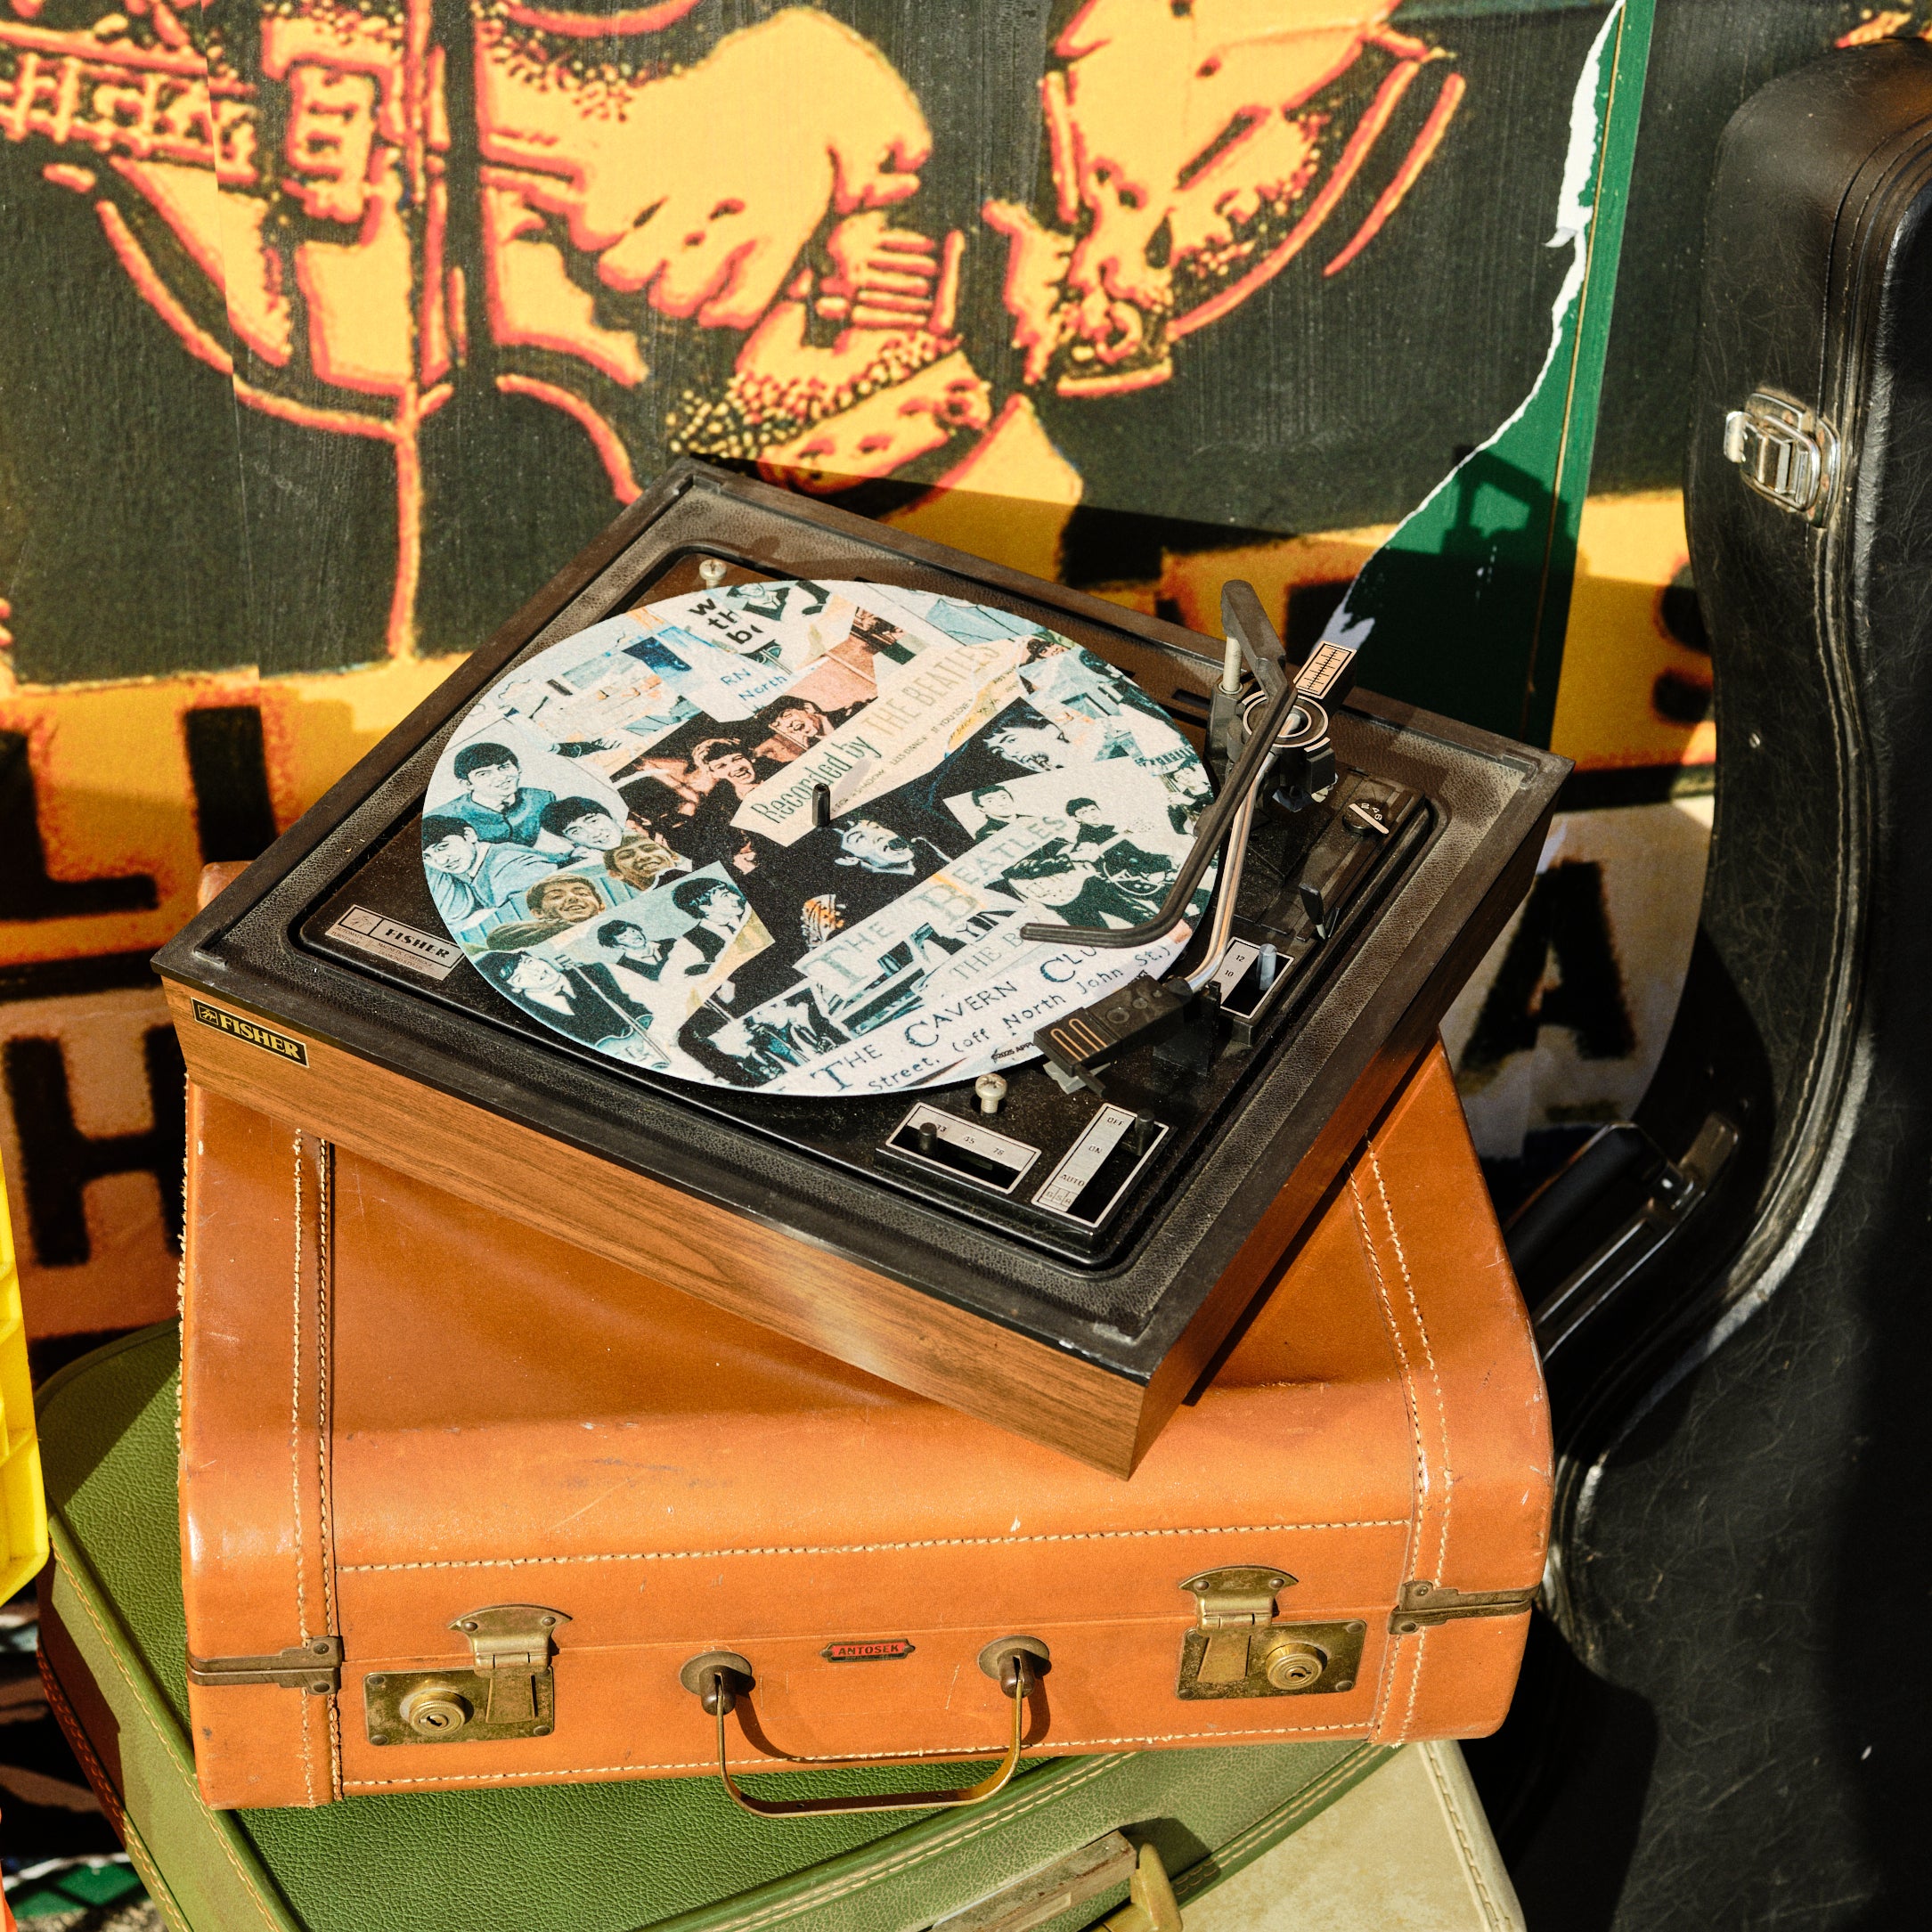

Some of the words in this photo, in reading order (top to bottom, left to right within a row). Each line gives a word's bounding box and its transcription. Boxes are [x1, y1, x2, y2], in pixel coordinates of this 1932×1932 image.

[738, 675, 788, 701] North
[750, 751, 853, 825] Recorded
[830, 736, 883, 759] by
[860, 697, 920, 737] THE
[902, 645, 1000, 707] BEATLES
[804, 921, 894, 984] THE
[910, 815, 1067, 925] BEATLES
[385, 928, 451, 958] FISHER
[950, 947, 1001, 981] THE
[1235, 954, 1245, 963] 12
[1225, 969, 1235, 977] 10
[810, 1044, 883, 1092] THE
[904, 981, 1018, 1048] CAVERN
[1039, 947, 1097, 982] CLU
[952, 1028, 991, 1053] (off
[1002, 994, 1066, 1030] North
[1075, 966, 1124, 995] John
[217, 1014, 301, 1060] FISHER
[1106, 1116, 1125, 1127] OFF
[1088, 1145, 1104, 1155] ON
[1060, 1174, 1086, 1187] AUTO
[837, 1644, 901, 1656] ANTOSEK
